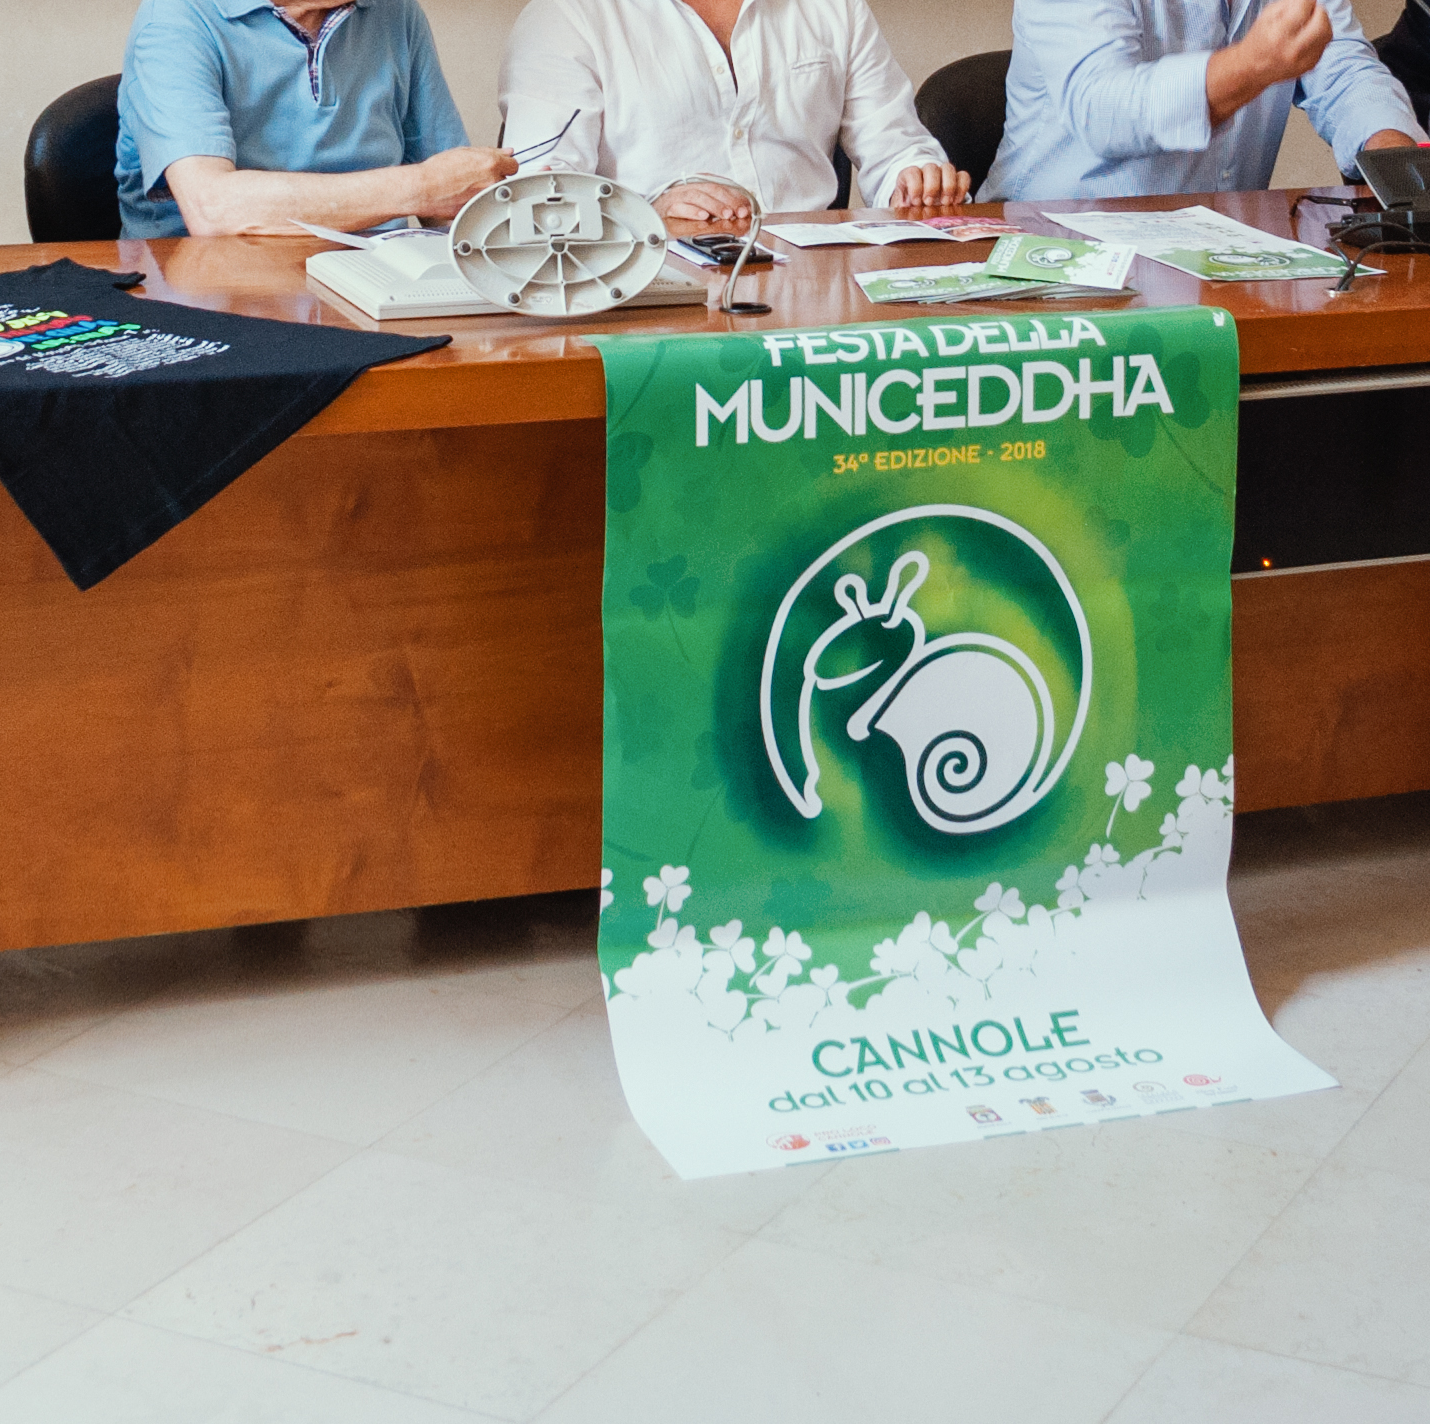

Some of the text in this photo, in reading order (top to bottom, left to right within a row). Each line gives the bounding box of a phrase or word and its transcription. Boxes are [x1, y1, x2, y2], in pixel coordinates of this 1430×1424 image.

[763, 317, 1106, 367] FESTA DELLA
[695, 354, 1175, 448] MUNICEDDHA
[873, 444, 981, 471] EDIZIONE
[999, 439, 1047, 462] 2018
[811, 1009, 1092, 1078] CANNOLE
[768, 1047, 1164, 1113] dal 10 al 13 agosto
